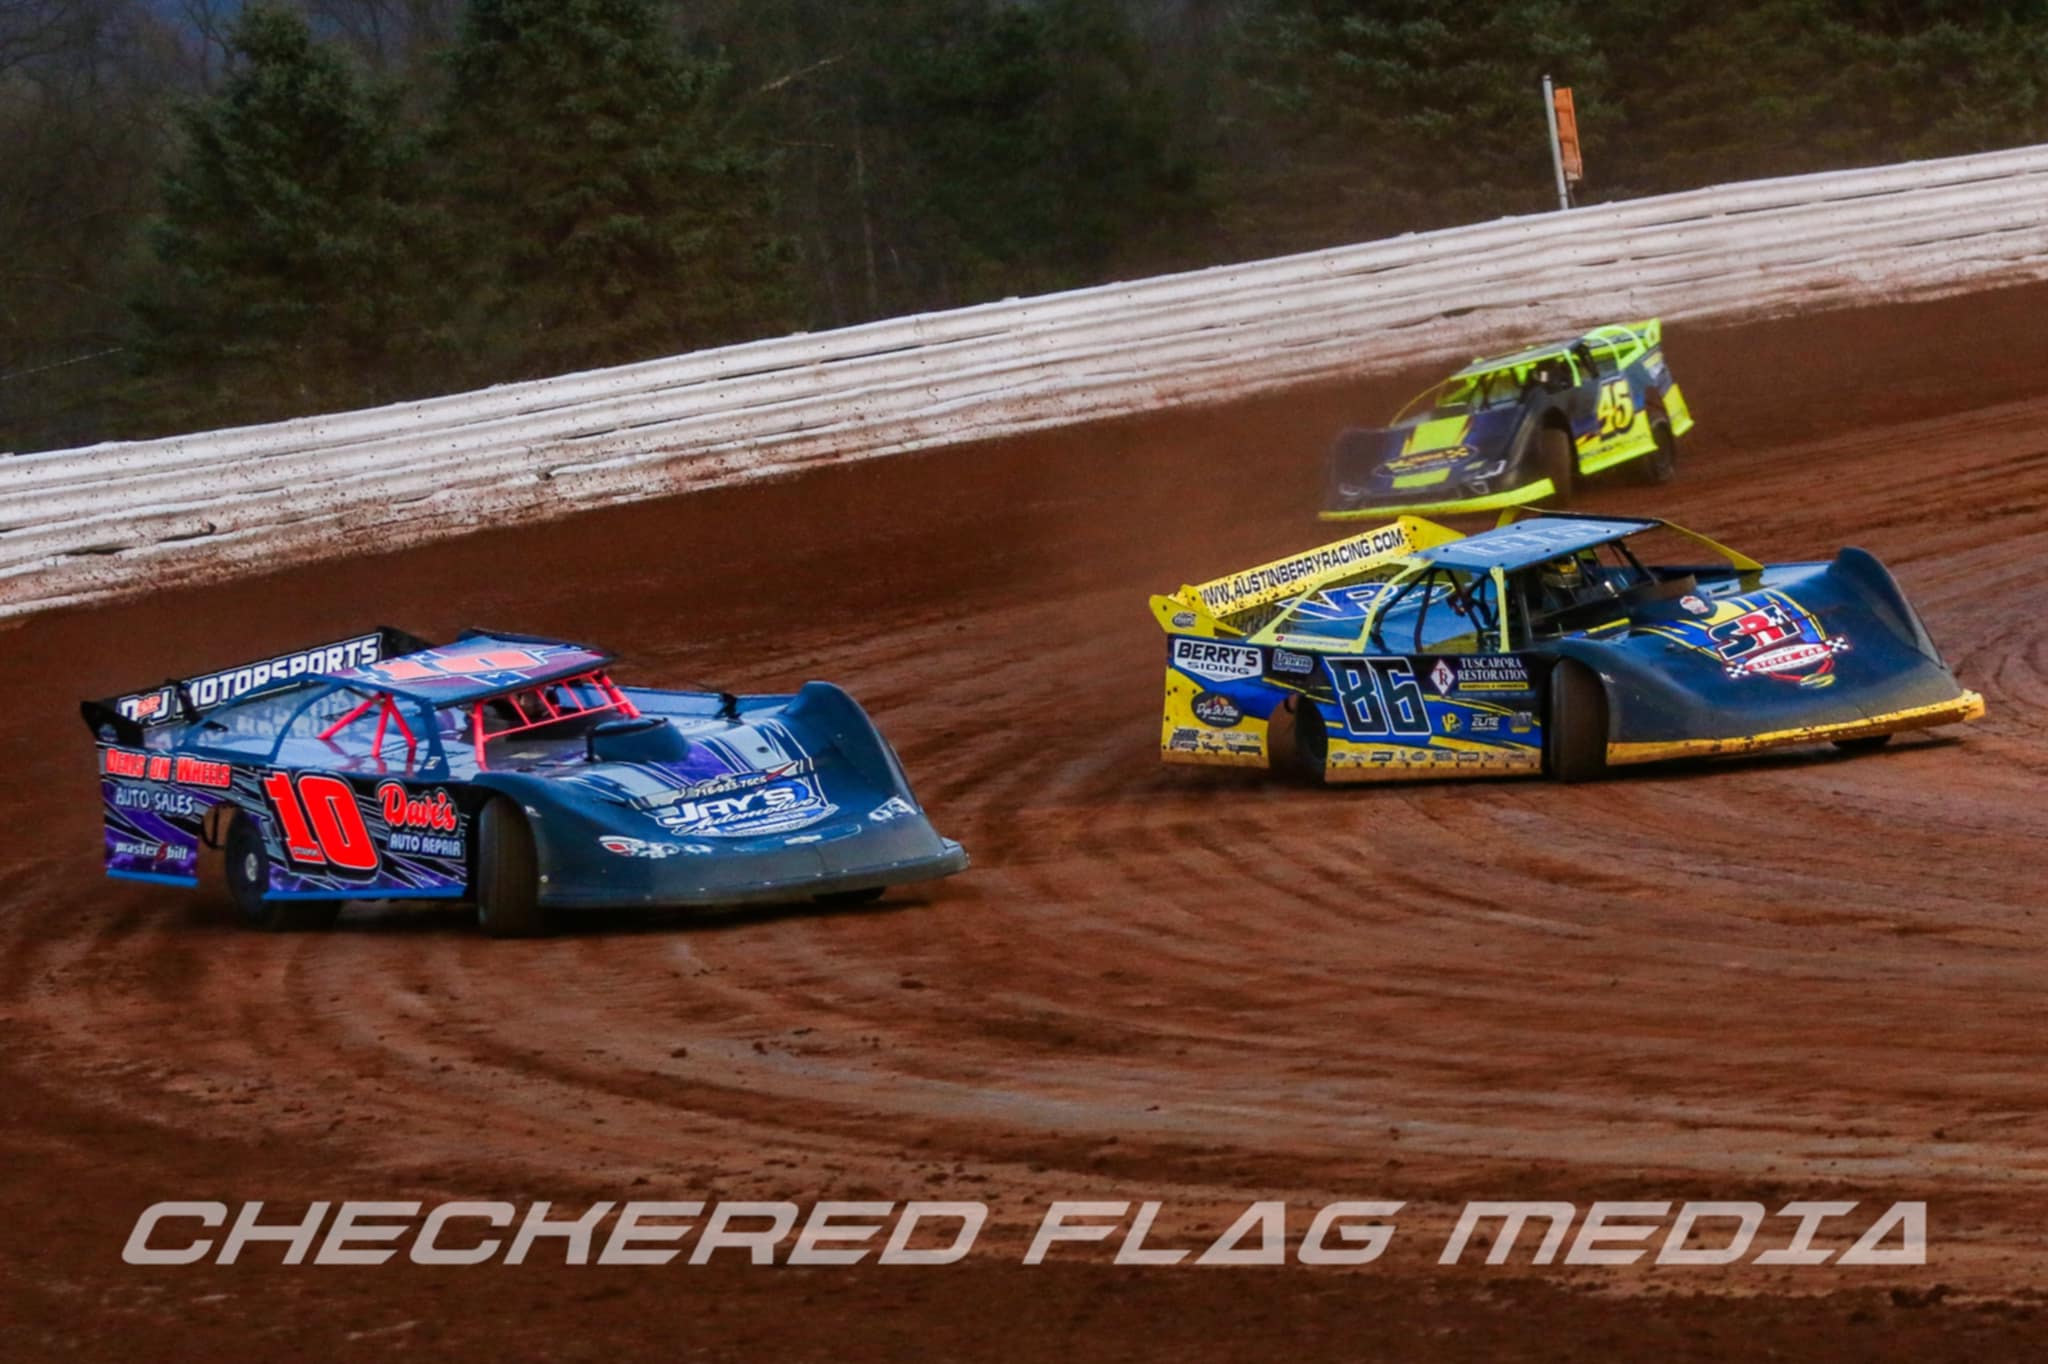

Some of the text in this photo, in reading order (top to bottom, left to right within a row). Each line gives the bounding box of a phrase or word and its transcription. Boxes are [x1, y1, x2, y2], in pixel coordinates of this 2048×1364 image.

[1597, 380, 1635, 440] 45
[1177, 642, 1258, 667] BERRY'S
[1186, 661, 1250, 676] SIDING
[1460, 657, 1522, 670] TUSCARORA
[176, 637, 379, 711] MOTORSPORTS
[1456, 669, 1529, 682] RESTORATION
[1324, 656, 1432, 736] 86
[149, 756, 172, 780] ON
[176, 756, 231, 788] WHEELS
[116, 786, 193, 815] AUTO SALES
[378, 783, 457, 831] Dave's
[663, 786, 796, 824] JAY'S
[264, 771, 378, 870] 10
[390, 834, 461, 857] AUTO REPAIR
